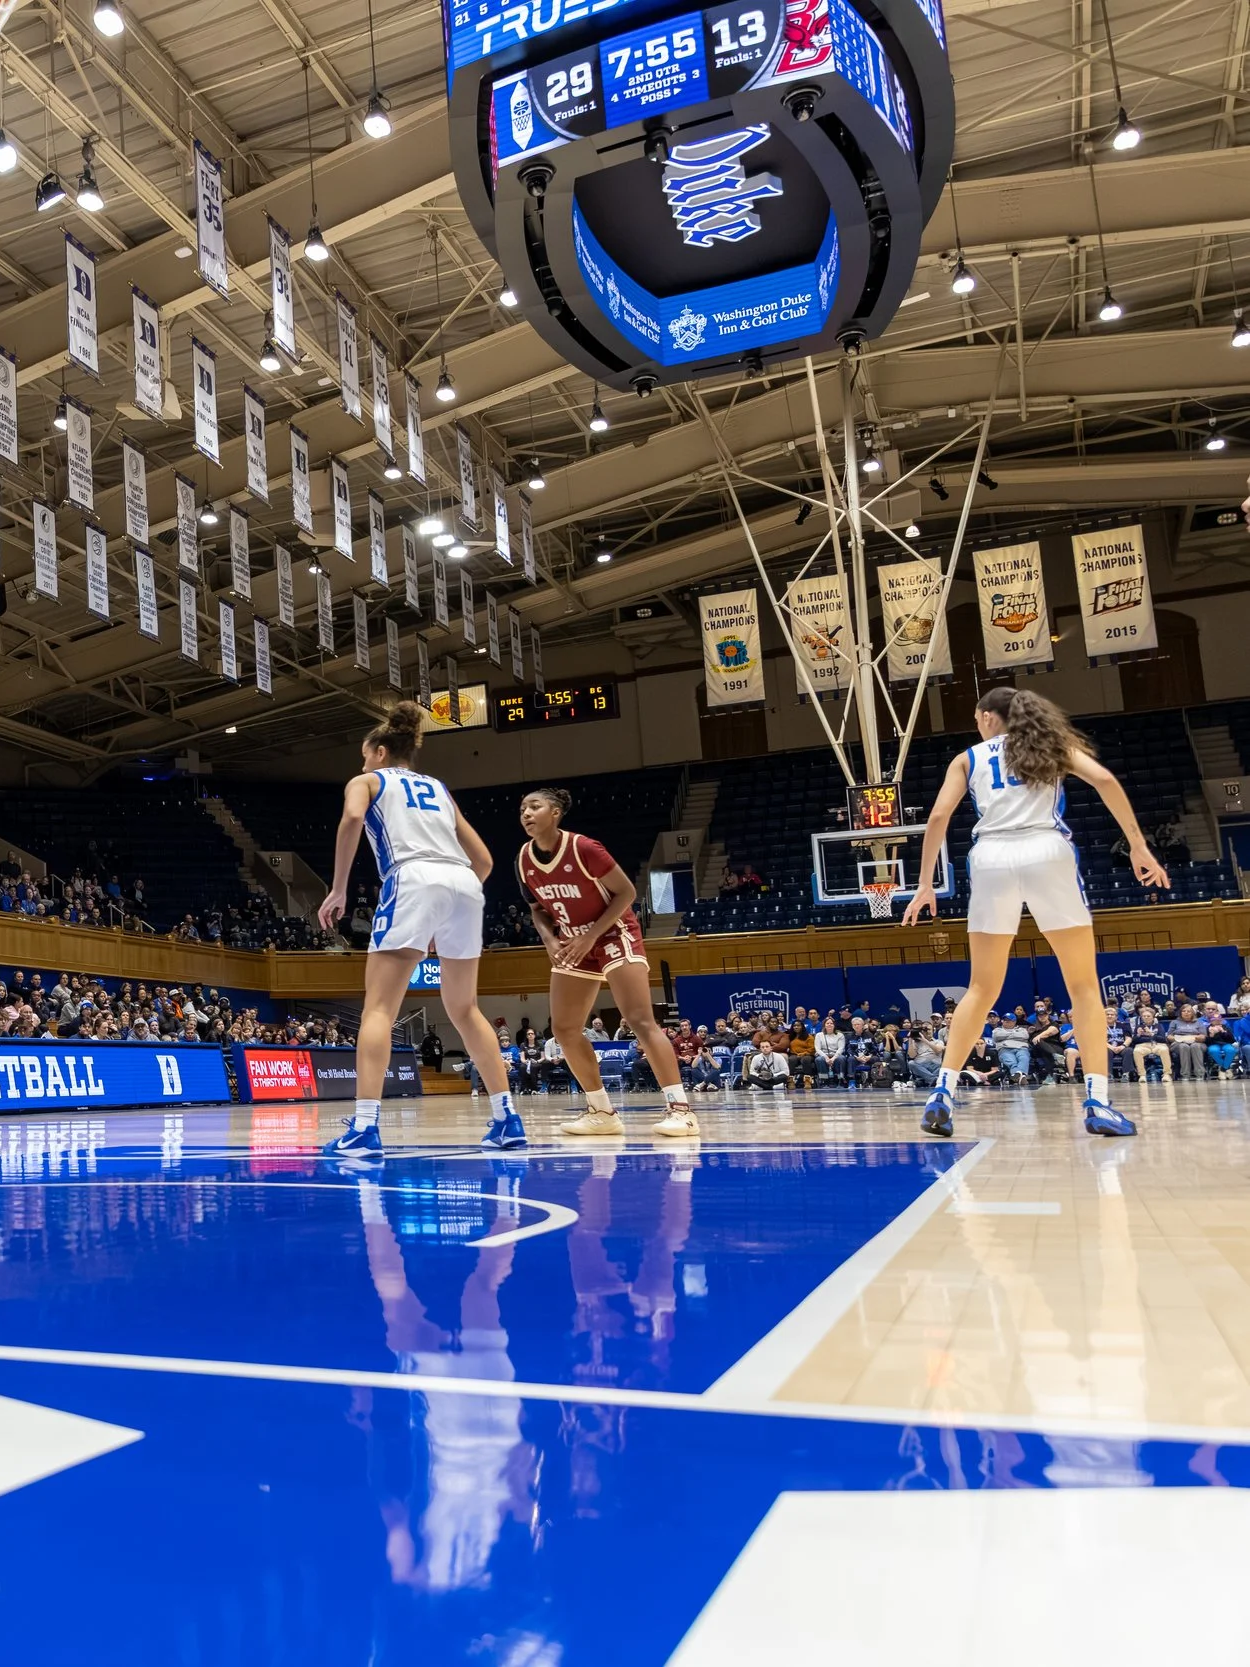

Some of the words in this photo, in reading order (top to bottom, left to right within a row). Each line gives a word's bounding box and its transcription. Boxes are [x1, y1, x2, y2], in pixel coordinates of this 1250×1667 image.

[455, 12, 471, 26] 21
[480, 4, 488, 15] 5
[711, 10, 766, 54] 13
[608, 28, 696, 79] 7:55
[715, 52, 752, 68] Fouls:
[754, 48, 762, 58] 1
[628, 72, 652, 86] 2ND
[656, 63, 680, 79] QTR
[546, 62, 593, 107] 29
[610, 92, 618, 103] 4
[624, 73, 686, 99] TIMEOUTS
[692, 69, 700, 80] 3
[640, 89, 671, 106] POSS
[554, 104, 588, 122] Fouls:
[589, 100, 596, 110] 1
[202, 193, 222, 232] 35
[712, 303, 778, 324] Washington
[781, 293, 812, 309] Duke
[70, 316, 84, 332] FINAL
[718, 323, 737, 336] Inn
[740, 318, 750, 331] &
[752, 312, 778, 328] Golf
[344, 340, 353, 368] 11
[1084, 542, 1135, 559] NATIONAL
[984, 558, 1032, 574] NATIONAL
[1080, 554, 1142, 572] CHAMPIONS
[981, 570, 1039, 588] CHAMPIONS
[1108, 579, 1142, 596] FINAL
[797, 588, 840, 604] NATIONAL
[1096, 589, 1142, 612] FOUR
[708, 604, 750, 618] NATIONAL
[704, 614, 756, 631] CHAMPIONS
[1106, 625, 1137, 639] 2015
[1004, 639, 1034, 652] 2010
[906, 654, 933, 665] 200
[813, 666, 840, 678] 1992
[723, 680, 748, 691] 1991
[501, 697, 523, 706] DUKE
[545, 691, 572, 704] 7:55
[594, 697, 606, 710] 13
[508, 708, 524, 721] 29
[400, 778, 440, 811] 12
[863, 788, 894, 802] 7:55
[870, 802, 891, 825] 12
[552, 902, 570, 924] 3
[735, 1000, 784, 1012] SISTERHOOD
[250, 1061, 268, 1076] FAN
[268, 1061, 295, 1076] WORK
[253, 1078, 258, 1087] IS
[258, 1078, 282, 1087] THIRSTY
[282, 1077, 298, 1086] WORK
